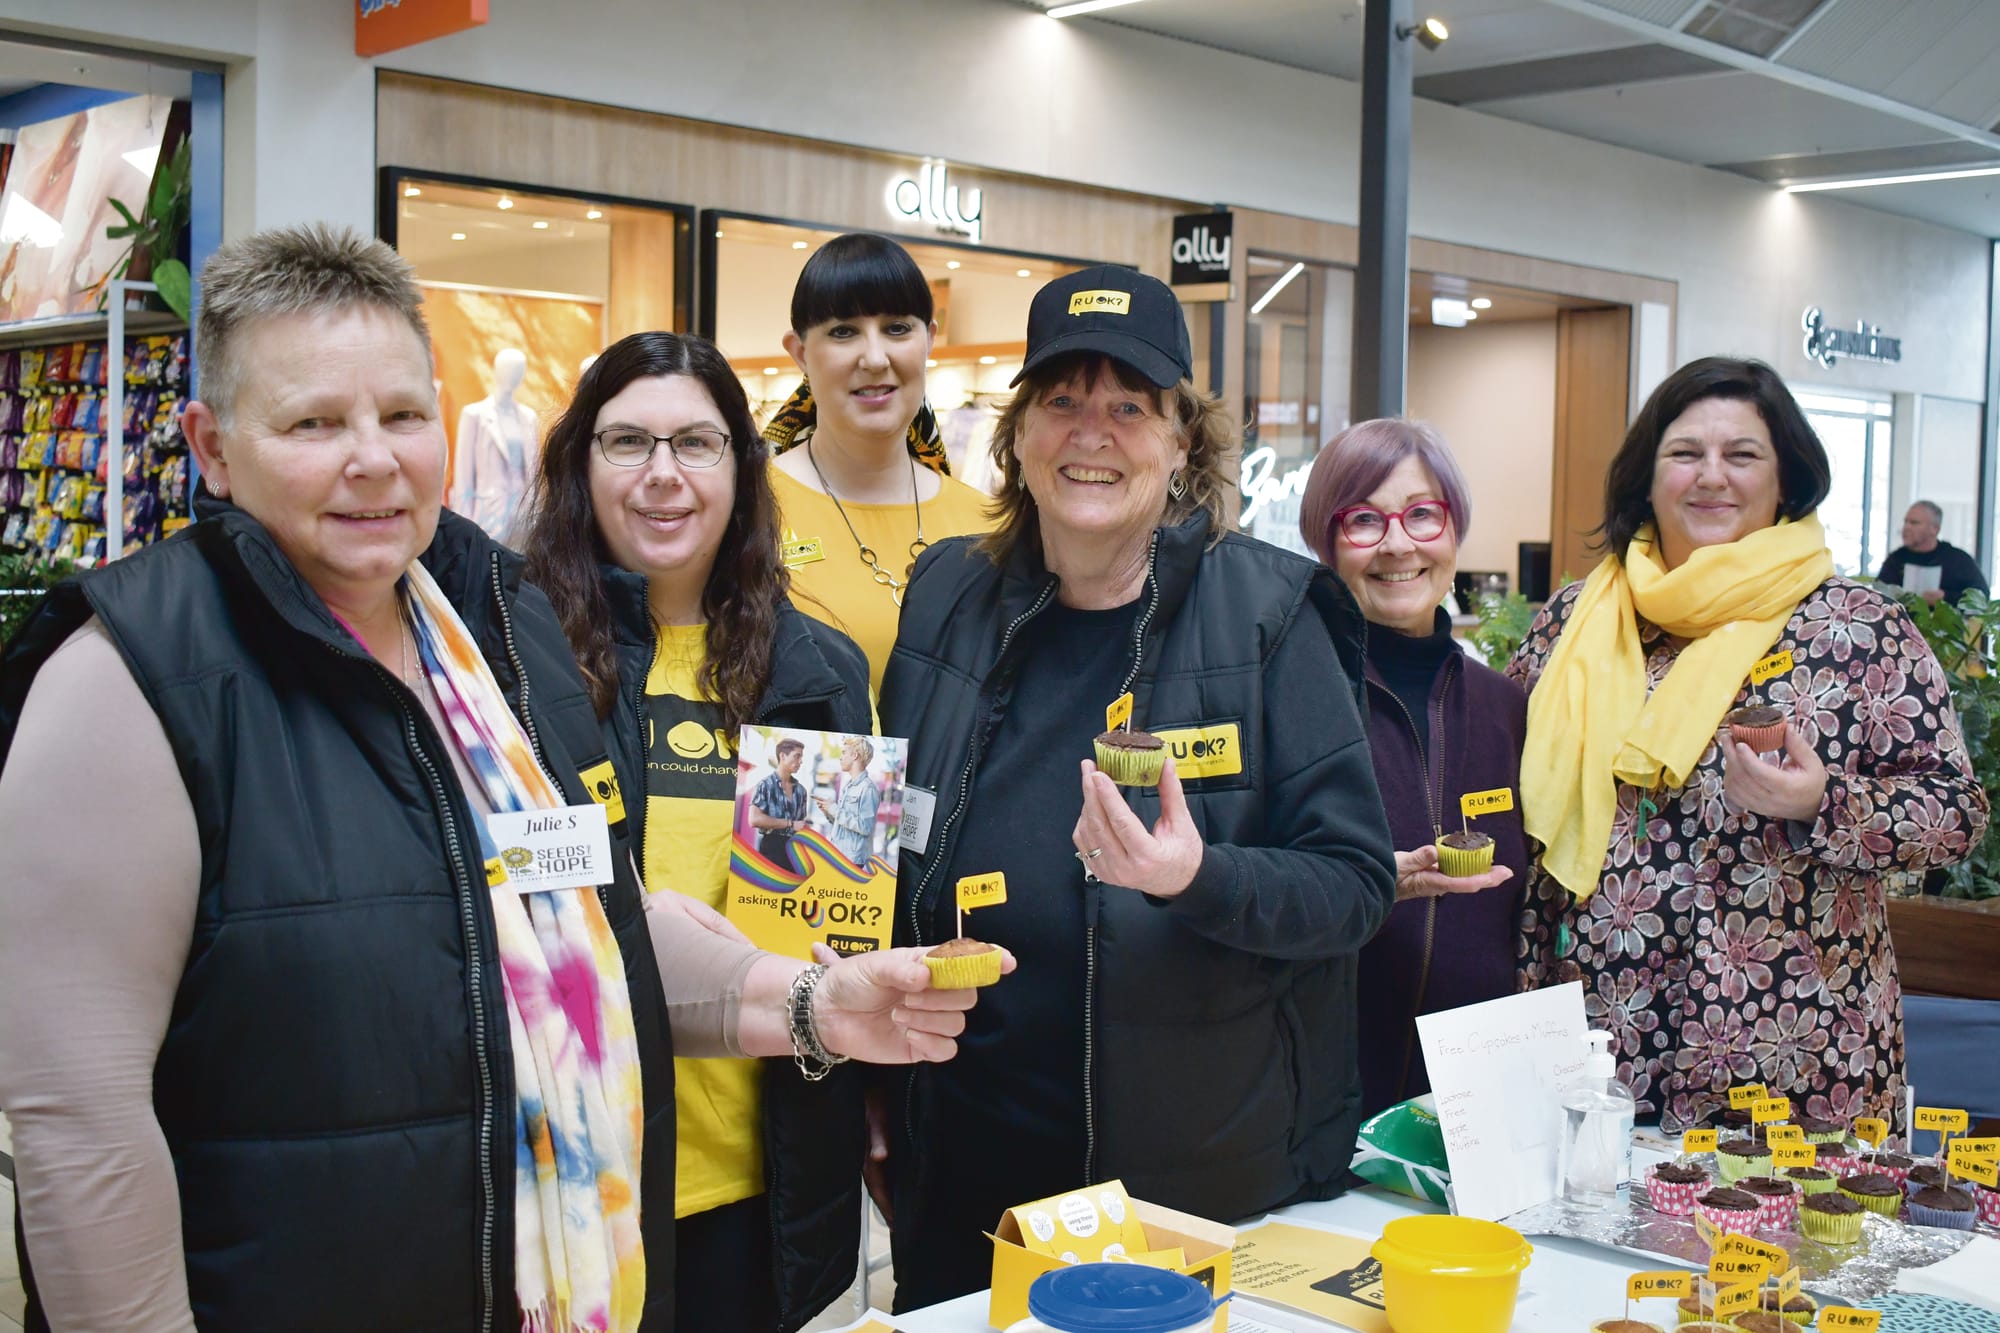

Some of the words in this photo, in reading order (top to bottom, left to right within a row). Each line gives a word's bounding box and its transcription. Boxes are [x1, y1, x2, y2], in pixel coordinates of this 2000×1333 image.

[885, 157, 983, 243] ally
[1172, 226, 1231, 270] ally
[661, 763, 698, 773] could
[524, 817, 562, 836] Julie
[568, 815, 577, 829] S
[537, 846, 585, 860] SEEDS
[538, 855, 593, 874] HOPE
[737, 895, 778, 909] asking
[806, 886, 815, 896] A
[817, 888, 852, 900] guide
[855, 891, 868, 901] to
[1437, 1038, 1465, 1056] Free
[1468, 1031, 1521, 1054] Cupcakes
